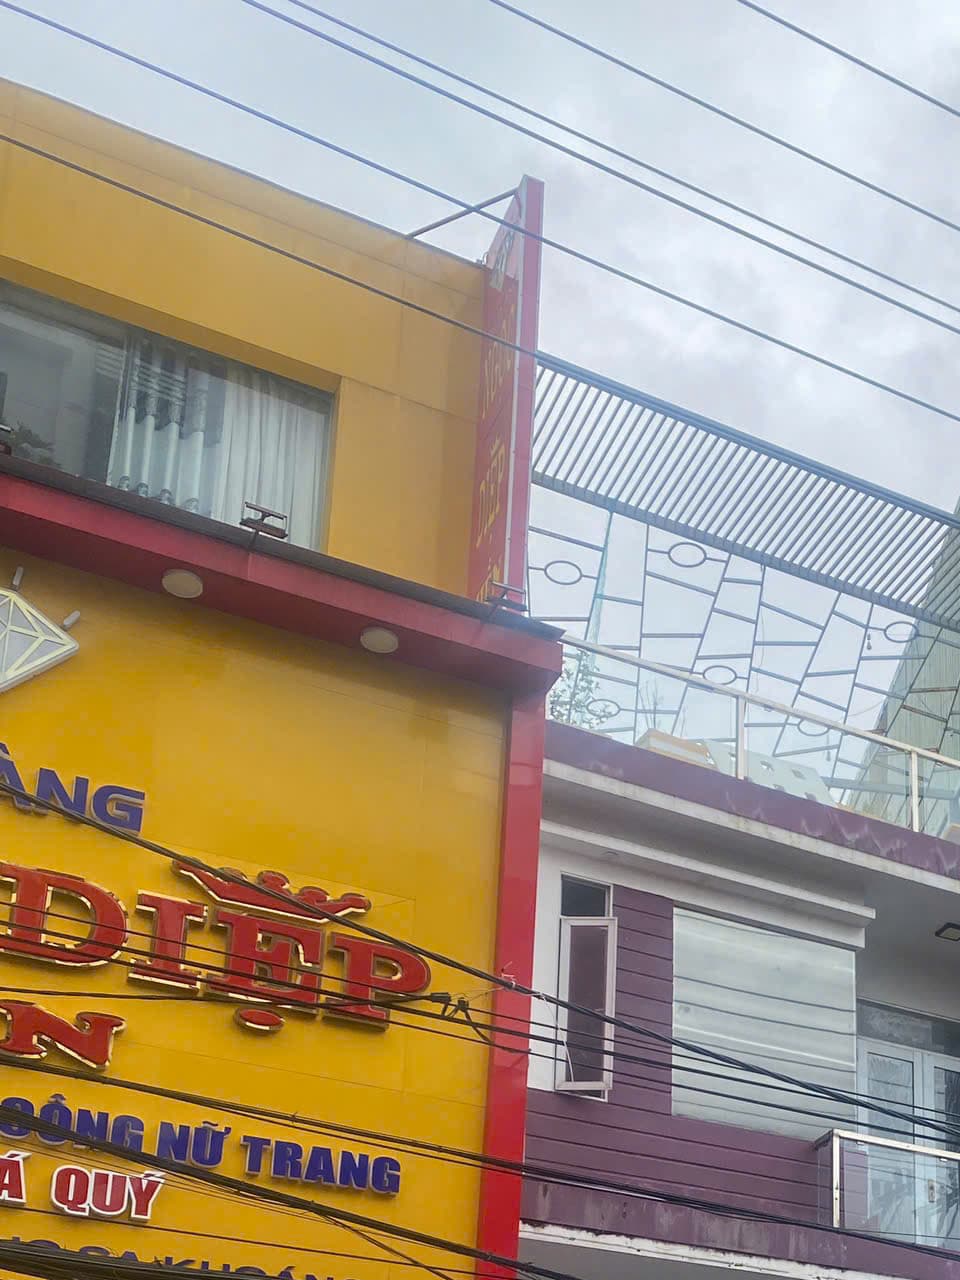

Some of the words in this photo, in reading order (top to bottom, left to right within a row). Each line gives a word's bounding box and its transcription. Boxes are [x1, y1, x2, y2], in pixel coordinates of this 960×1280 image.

[0, 742, 145, 833] ÀNG
[0, 999, 127, 1069] N
[0, 1150, 29, 1202] Á
[51, 1162, 167, 1221] QUÝ
[157, 1120, 231, 1169] NỮ
[242, 1134, 401, 1197] TRANG
